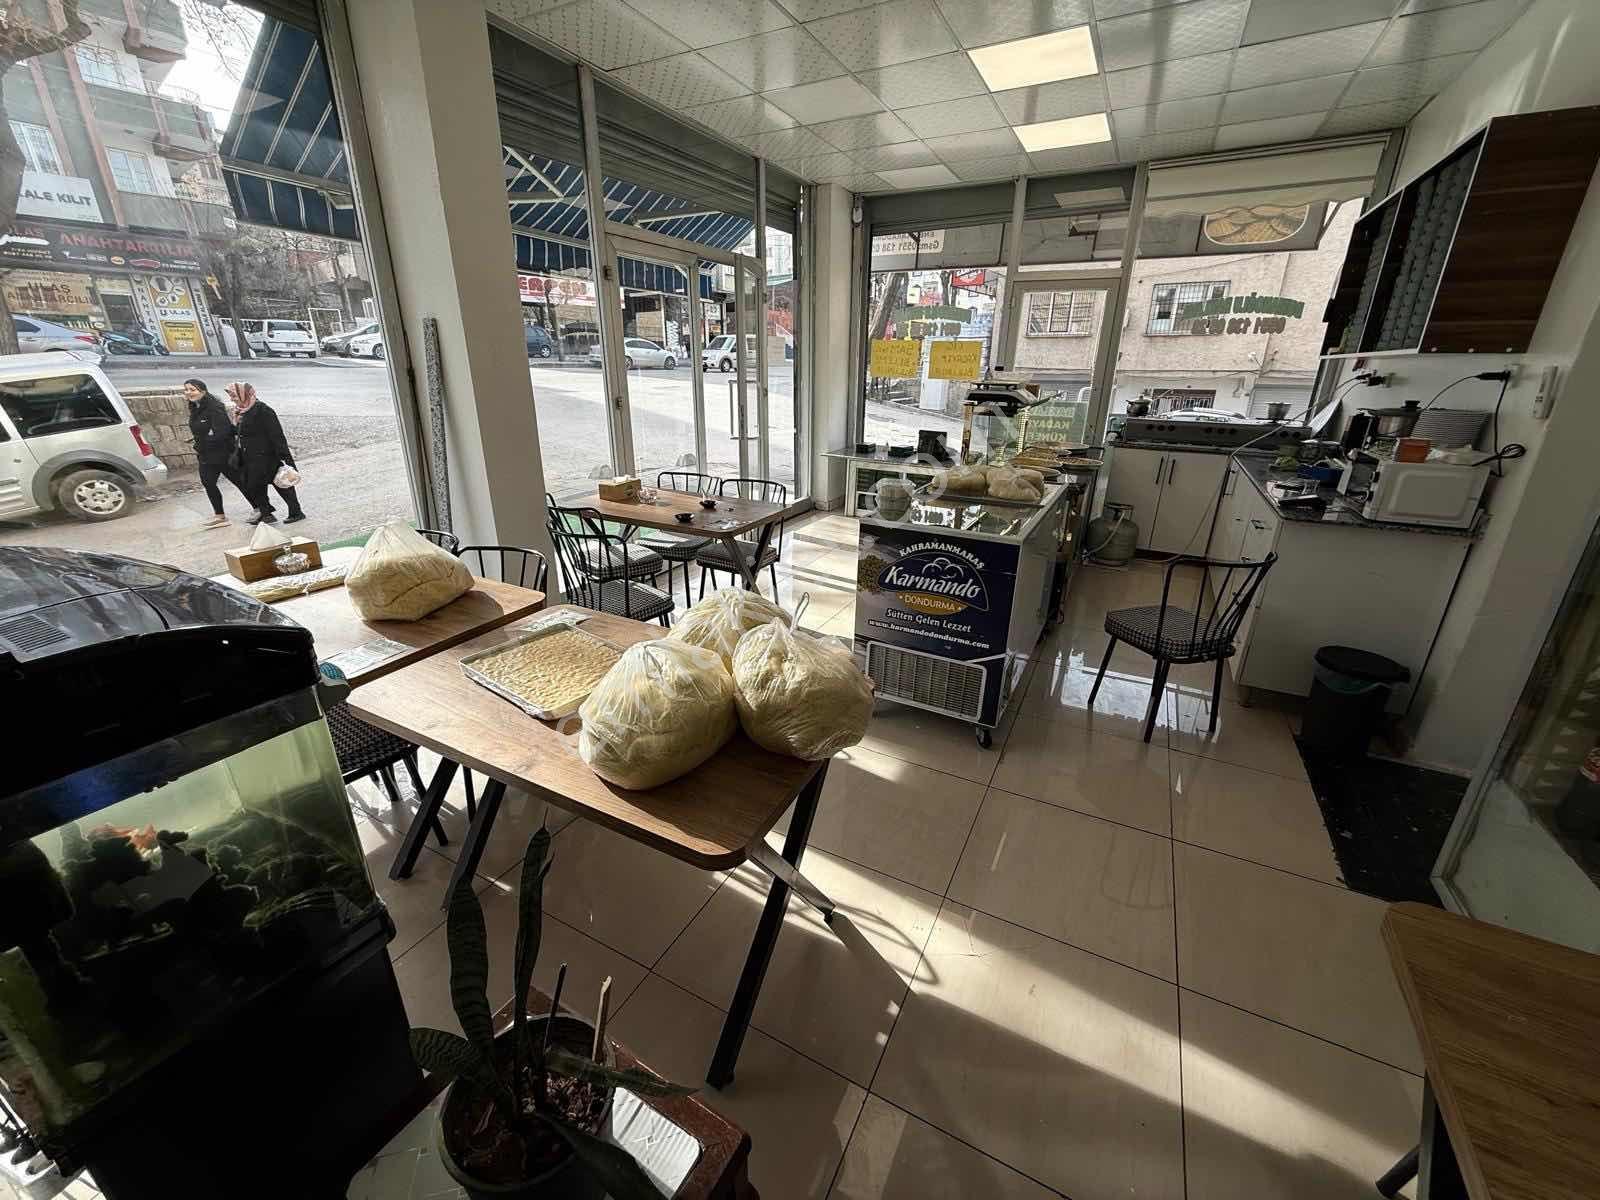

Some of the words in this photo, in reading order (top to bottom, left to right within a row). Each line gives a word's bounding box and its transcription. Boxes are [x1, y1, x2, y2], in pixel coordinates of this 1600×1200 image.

[885, 565, 983, 600] Karmando
[904, 594, 957, 612] DONDURMA
[887, 608, 913, 622] Sütten
[915, 614, 940, 628] Gelen
[942, 619, 972, 634] Lezzet
